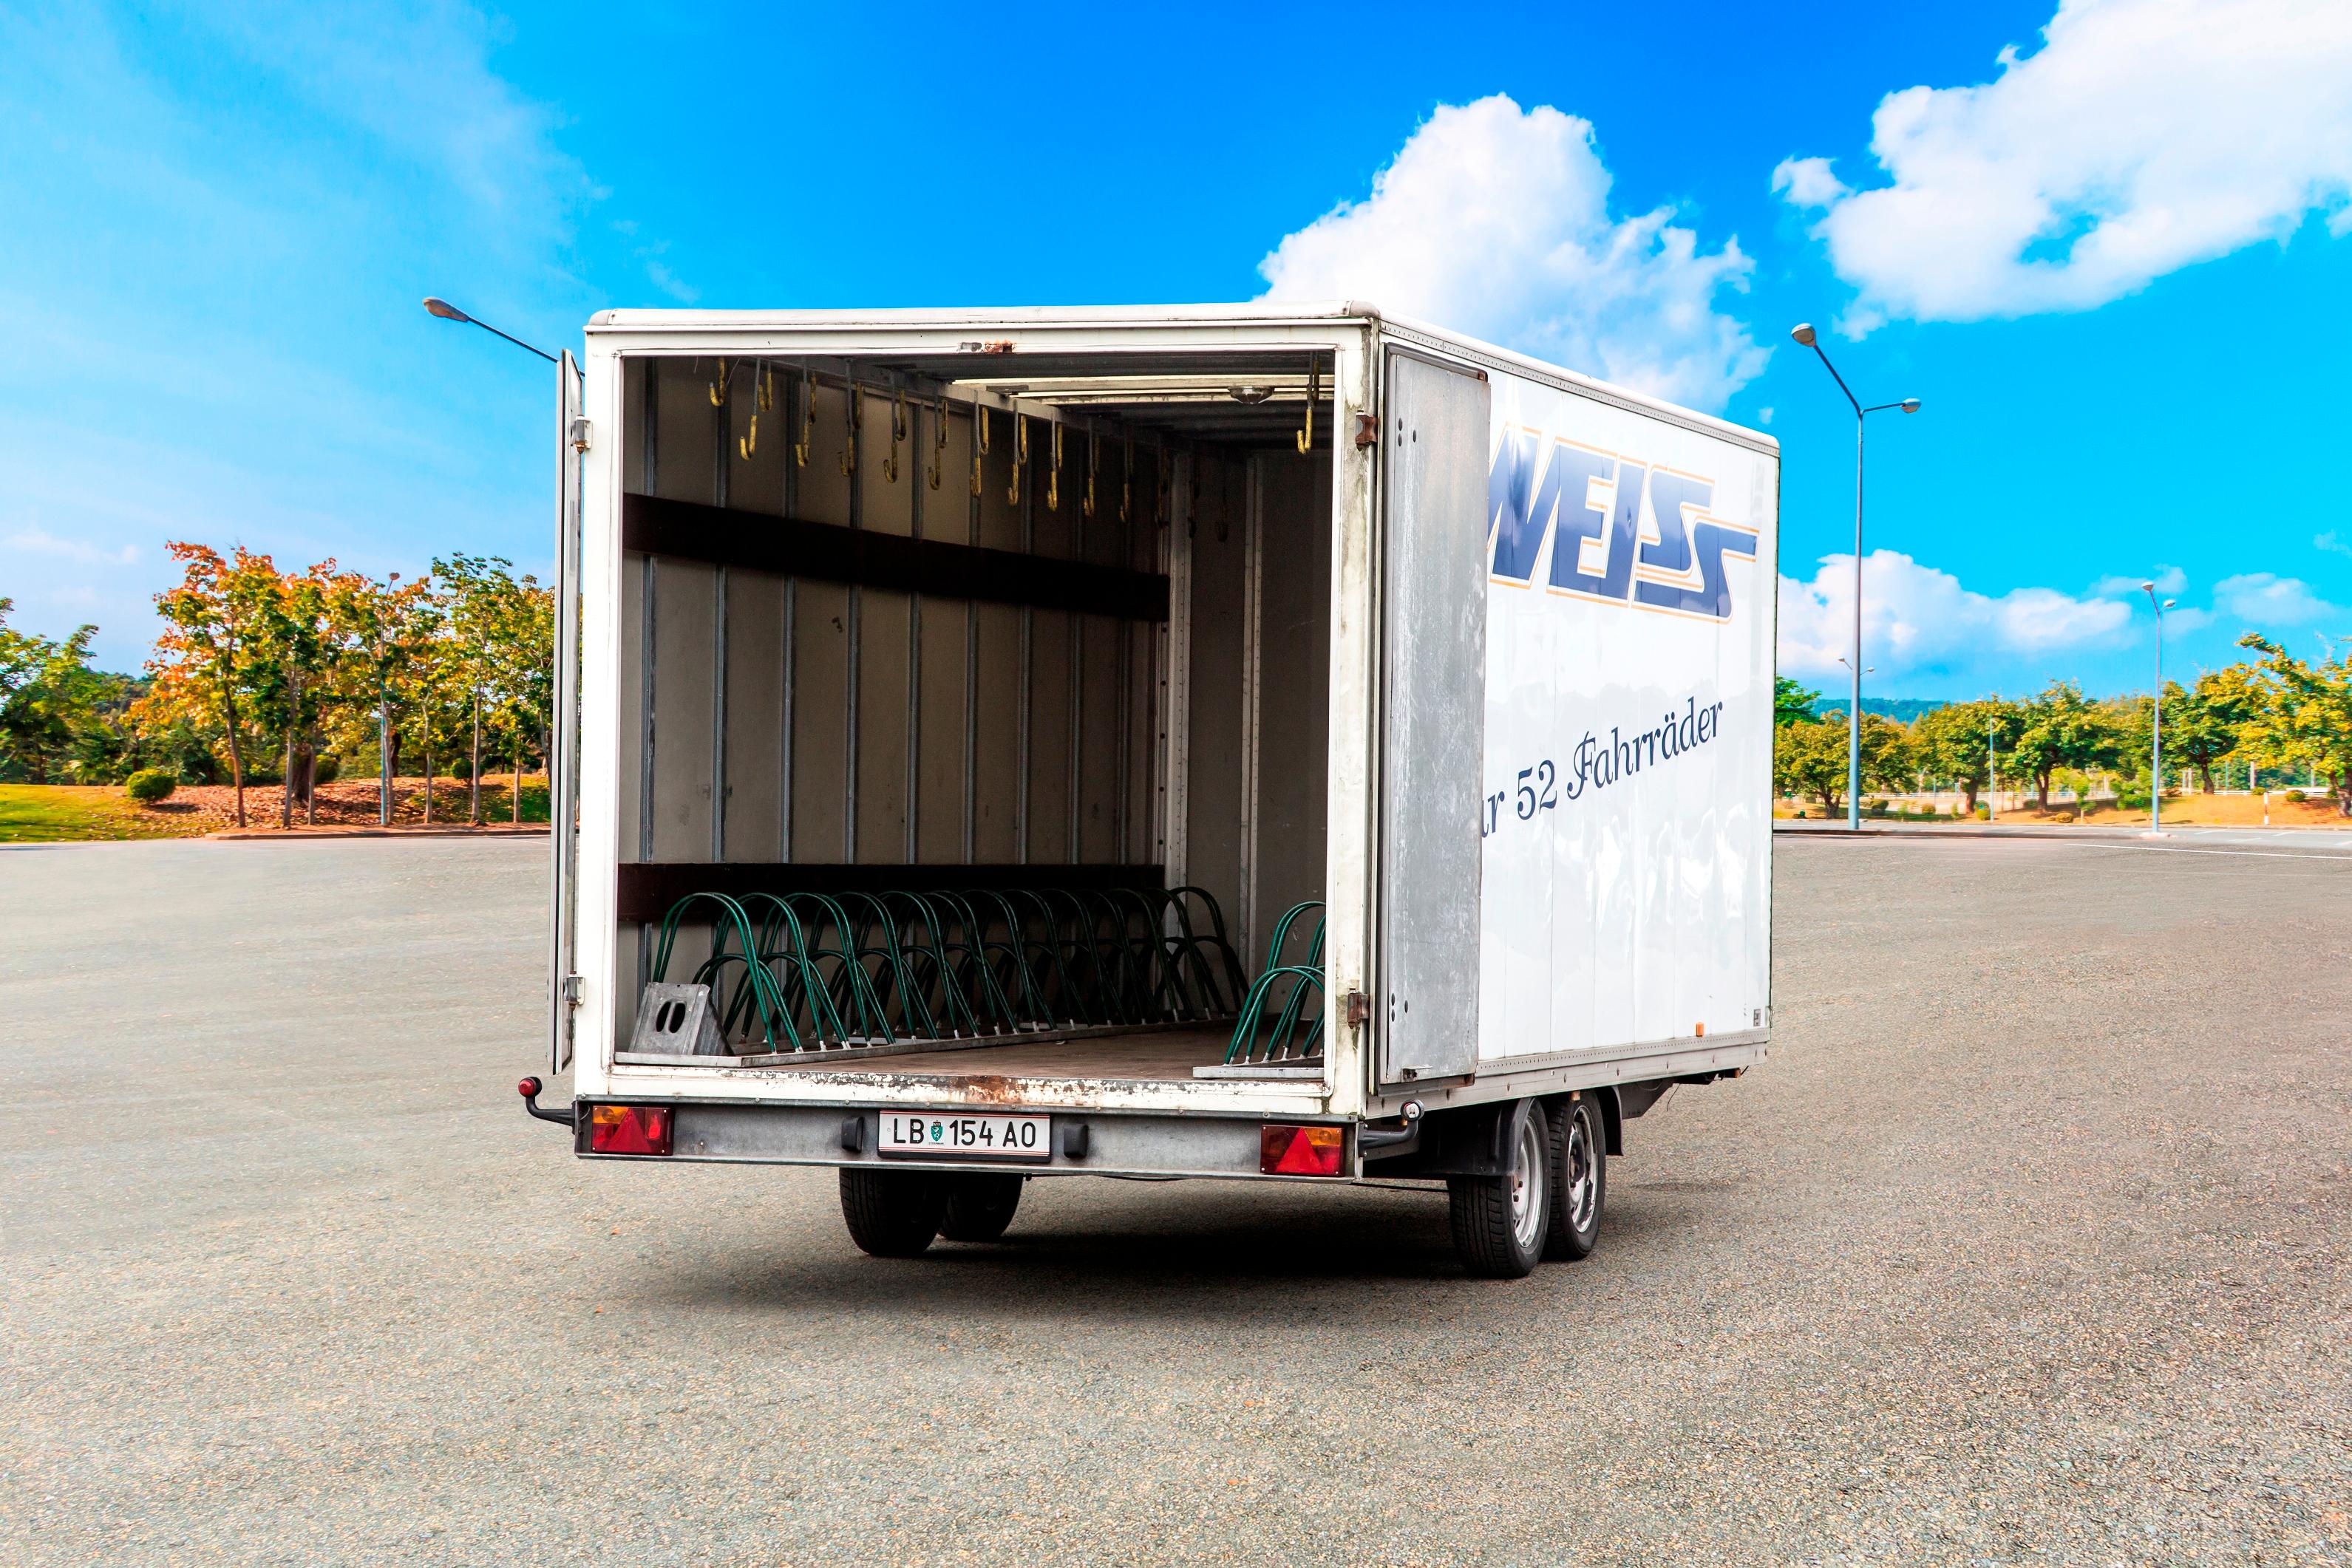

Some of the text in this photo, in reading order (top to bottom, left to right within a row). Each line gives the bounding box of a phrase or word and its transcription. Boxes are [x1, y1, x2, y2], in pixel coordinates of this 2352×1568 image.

[1486, 422, 1760, 624] WEISS
[1517, 760, 1557, 821] 52
[1566, 695, 1723, 800] Fahrräder
[894, 1117, 924, 1144] LB
[949, 1120, 993, 1146] 154
